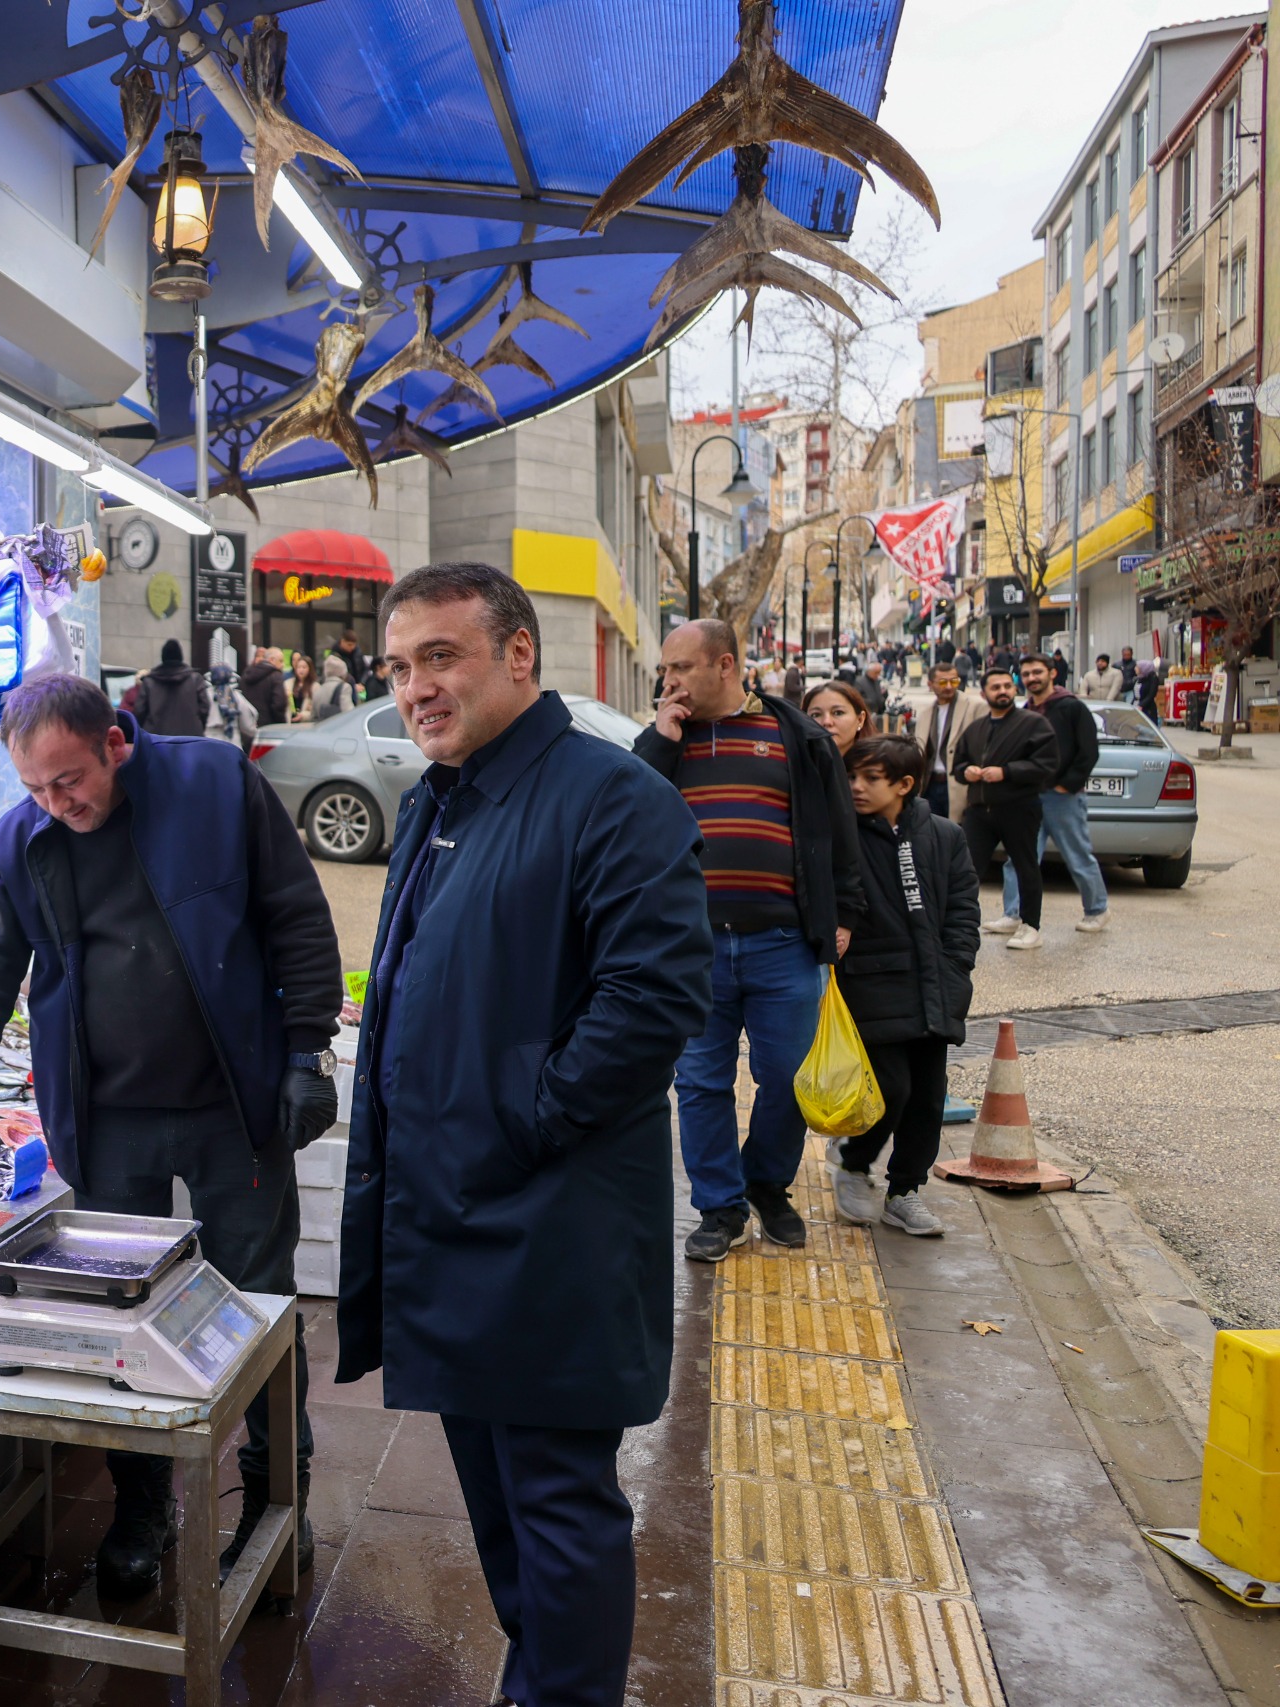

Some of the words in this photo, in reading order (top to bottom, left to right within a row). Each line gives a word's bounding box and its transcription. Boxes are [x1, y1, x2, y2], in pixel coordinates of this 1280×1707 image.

[1108, 778, 1122, 791] 81
[898, 841, 918, 887] FUTURE
[904, 887, 923, 912] THE
